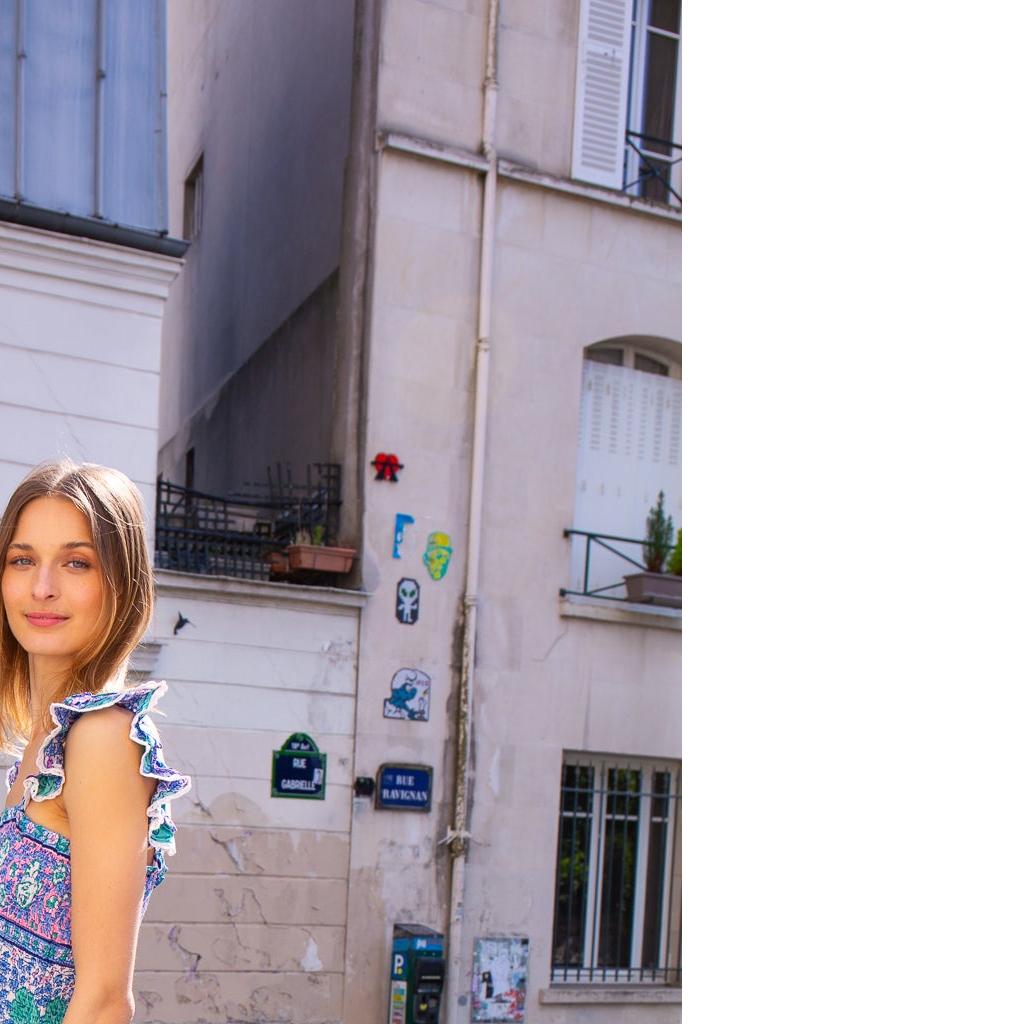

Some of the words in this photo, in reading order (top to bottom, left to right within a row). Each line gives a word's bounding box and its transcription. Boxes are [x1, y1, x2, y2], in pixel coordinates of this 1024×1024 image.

[292, 758, 307, 768] RUE
[396, 775, 415, 786] RUE
[383, 789, 428, 801] RAVIGNAN
